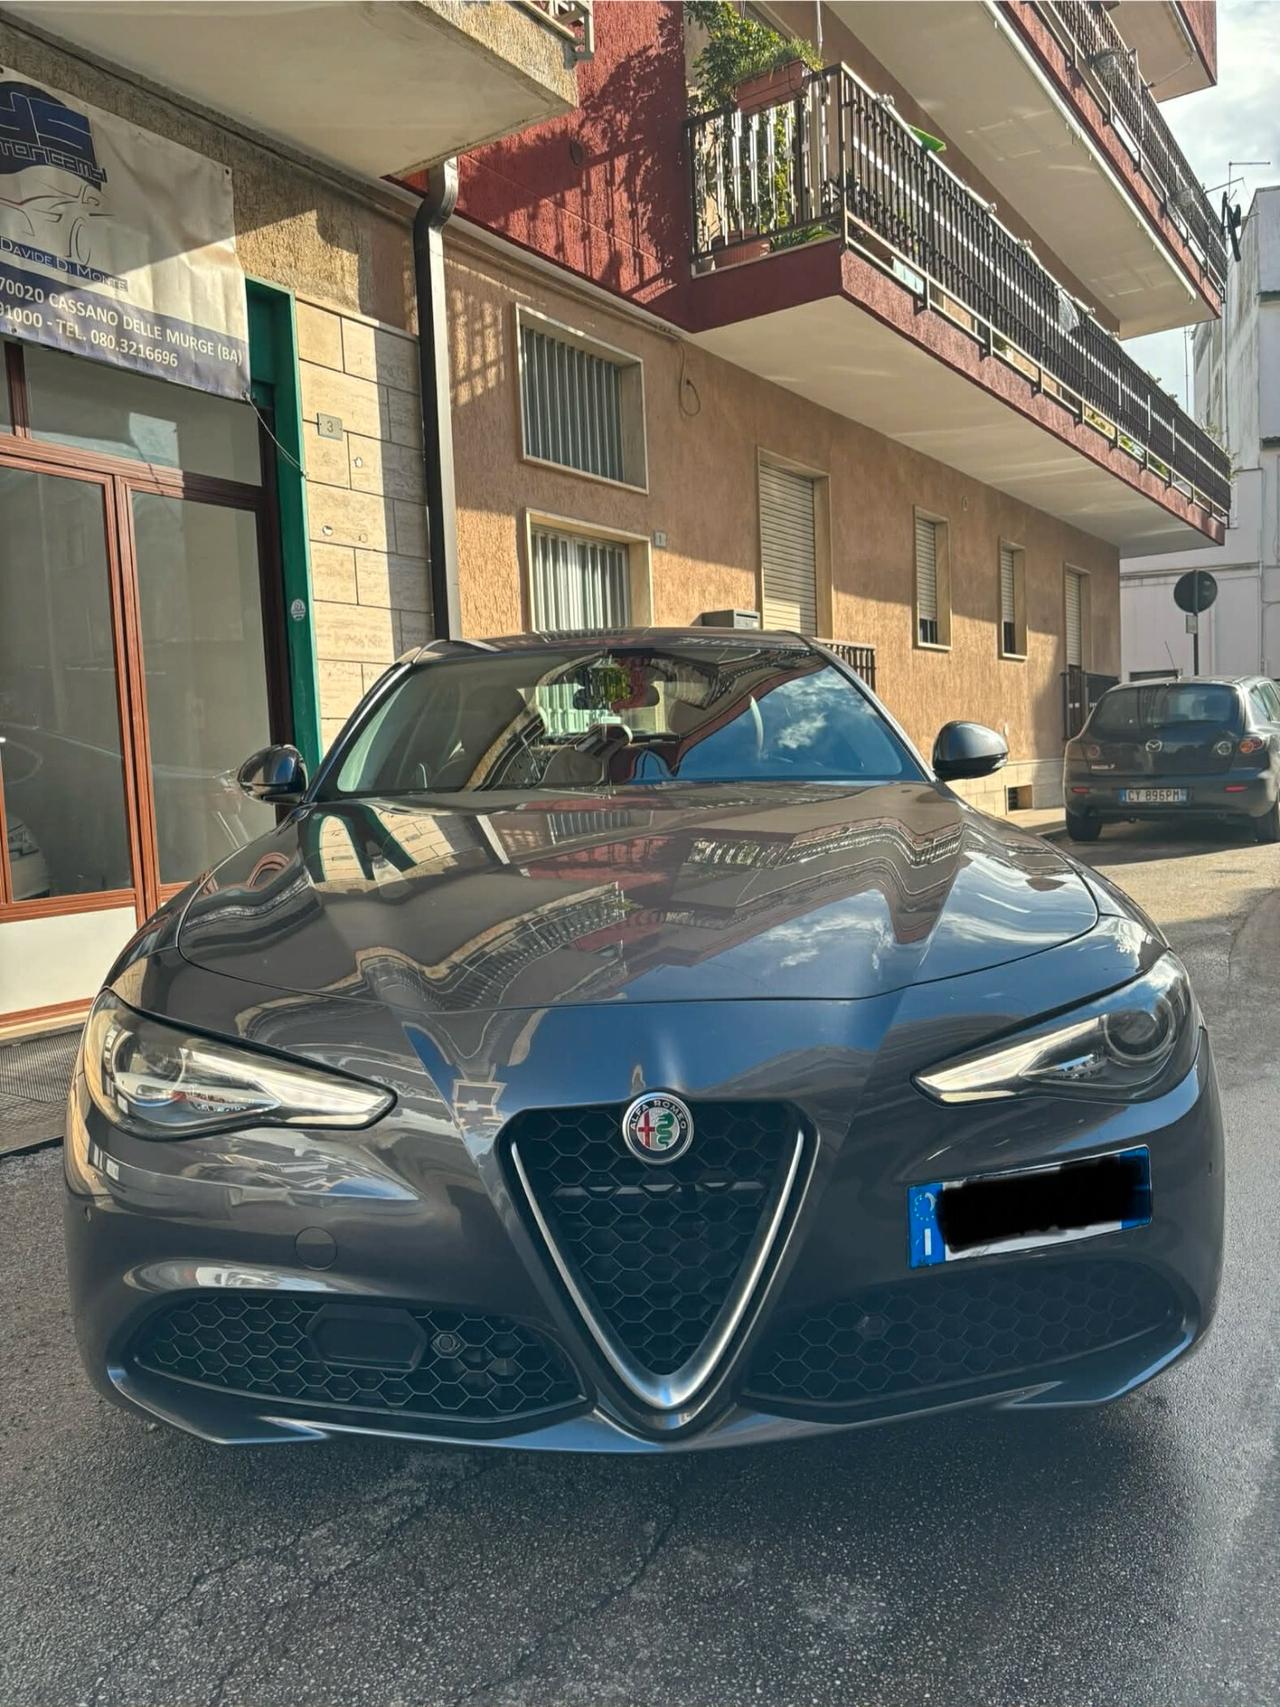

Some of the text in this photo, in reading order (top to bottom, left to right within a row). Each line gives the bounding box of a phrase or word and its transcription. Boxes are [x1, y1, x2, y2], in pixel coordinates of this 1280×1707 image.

[49, 293, 118, 326] CASSANO
[123, 315, 162, 340] DELLE
[166, 329, 214, 356] MURGE
[217, 343, 242, 366] (BA)
[55, 319, 87, 341] TEL.
[90, 329, 178, 367] 080.3216696
[326, 420, 334, 433] 3
[630, 1100, 687, 1130] ALFA ROMEO
